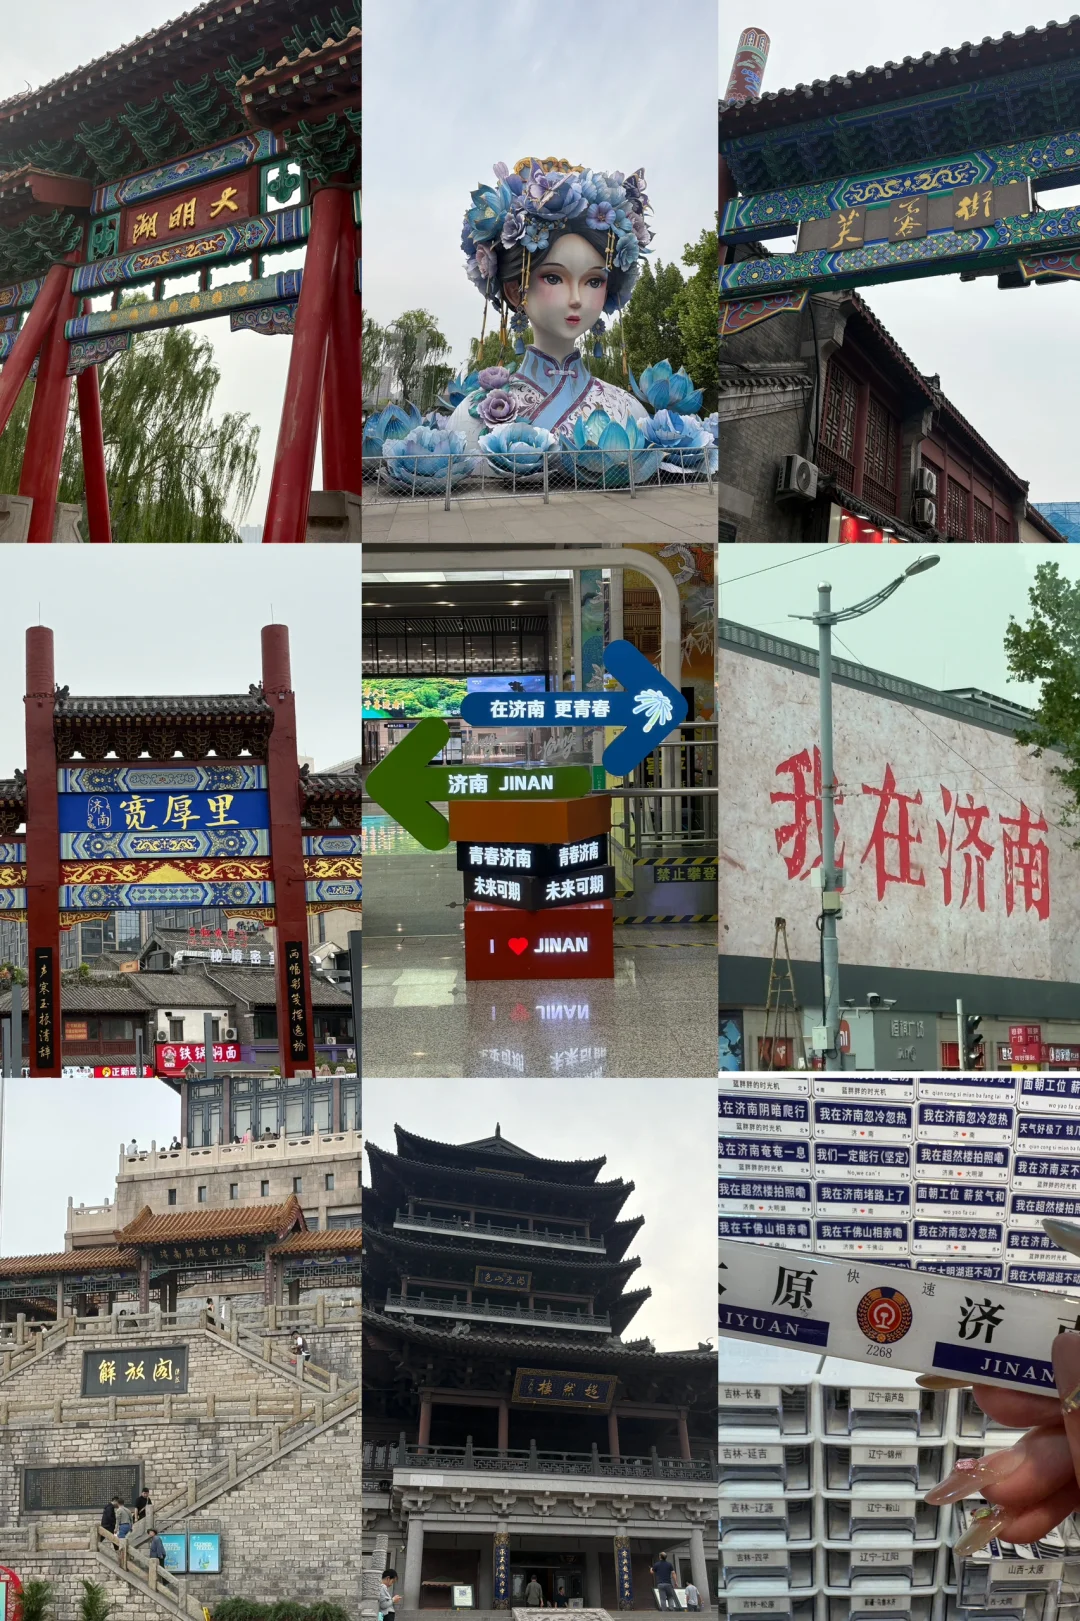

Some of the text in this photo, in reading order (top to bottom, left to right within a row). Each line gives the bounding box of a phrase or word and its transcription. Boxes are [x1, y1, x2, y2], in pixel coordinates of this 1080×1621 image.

[132, 186, 239, 245] 大明湖
[830, 190, 993, 249] 芙蓉街
[490, 699, 611, 718] 在济南 更青春
[448, 773, 554, 794] 济南 JINAN
[89, 798, 111, 827] 济南
[119, 794, 240, 830] 宽厚里
[771, 745, 1050, 921] 我在济南
[469, 846, 531, 868] 青春济南
[559, 841, 599, 867] 青春济南
[656, 867, 717, 881] 禁止攀登
[474, 876, 521, 901] 未来可期
[545, 874, 604, 901] 未来可期
[533, 937, 588, 953] JINAN
[820, 1107, 907, 1125] 我在济南忽冷忽热
[923, 1109, 1008, 1126] 我在济南忽冷忽热
[1020, 1123, 1062, 1135] 天气好极了
[718, 1142, 806, 1159] 我在济南奄奄一息
[816, 1148, 909, 1165] 我们一定能行(坚定)
[821, 1187, 905, 1202] 我在济南堵路上了
[917, 1186, 1005, 1203] 面朝工位 薪贫气和
[918, 1225, 998, 1240] 我在济南忽冷忽热
[847, 1268, 860, 1284] 快
[921, 1282, 937, 1298] 速
[866, 1344, 893, 1359] Z268
[98, 1357, 173, 1387] 解放阁
[980, 1357, 1055, 1383] JINAN
[724, 1387, 762, 1399] 吉林-长春
[868, 1392, 905, 1403] 辽宁-葫芦岛
[722, 1448, 768, 1459] 吉林-延吉
[730, 1502, 774, 1513] 吉林-辽源
[867, 1503, 900, 1512] 辽宁-鞍山
[736, 1553, 769, 1562] 吉林-四平
[860, 1551, 899, 1562] 辽宁-辽阳
[1007, 1565, 1044, 1575] 山西-太原
[743, 1600, 775, 1609] 吉林-松原
